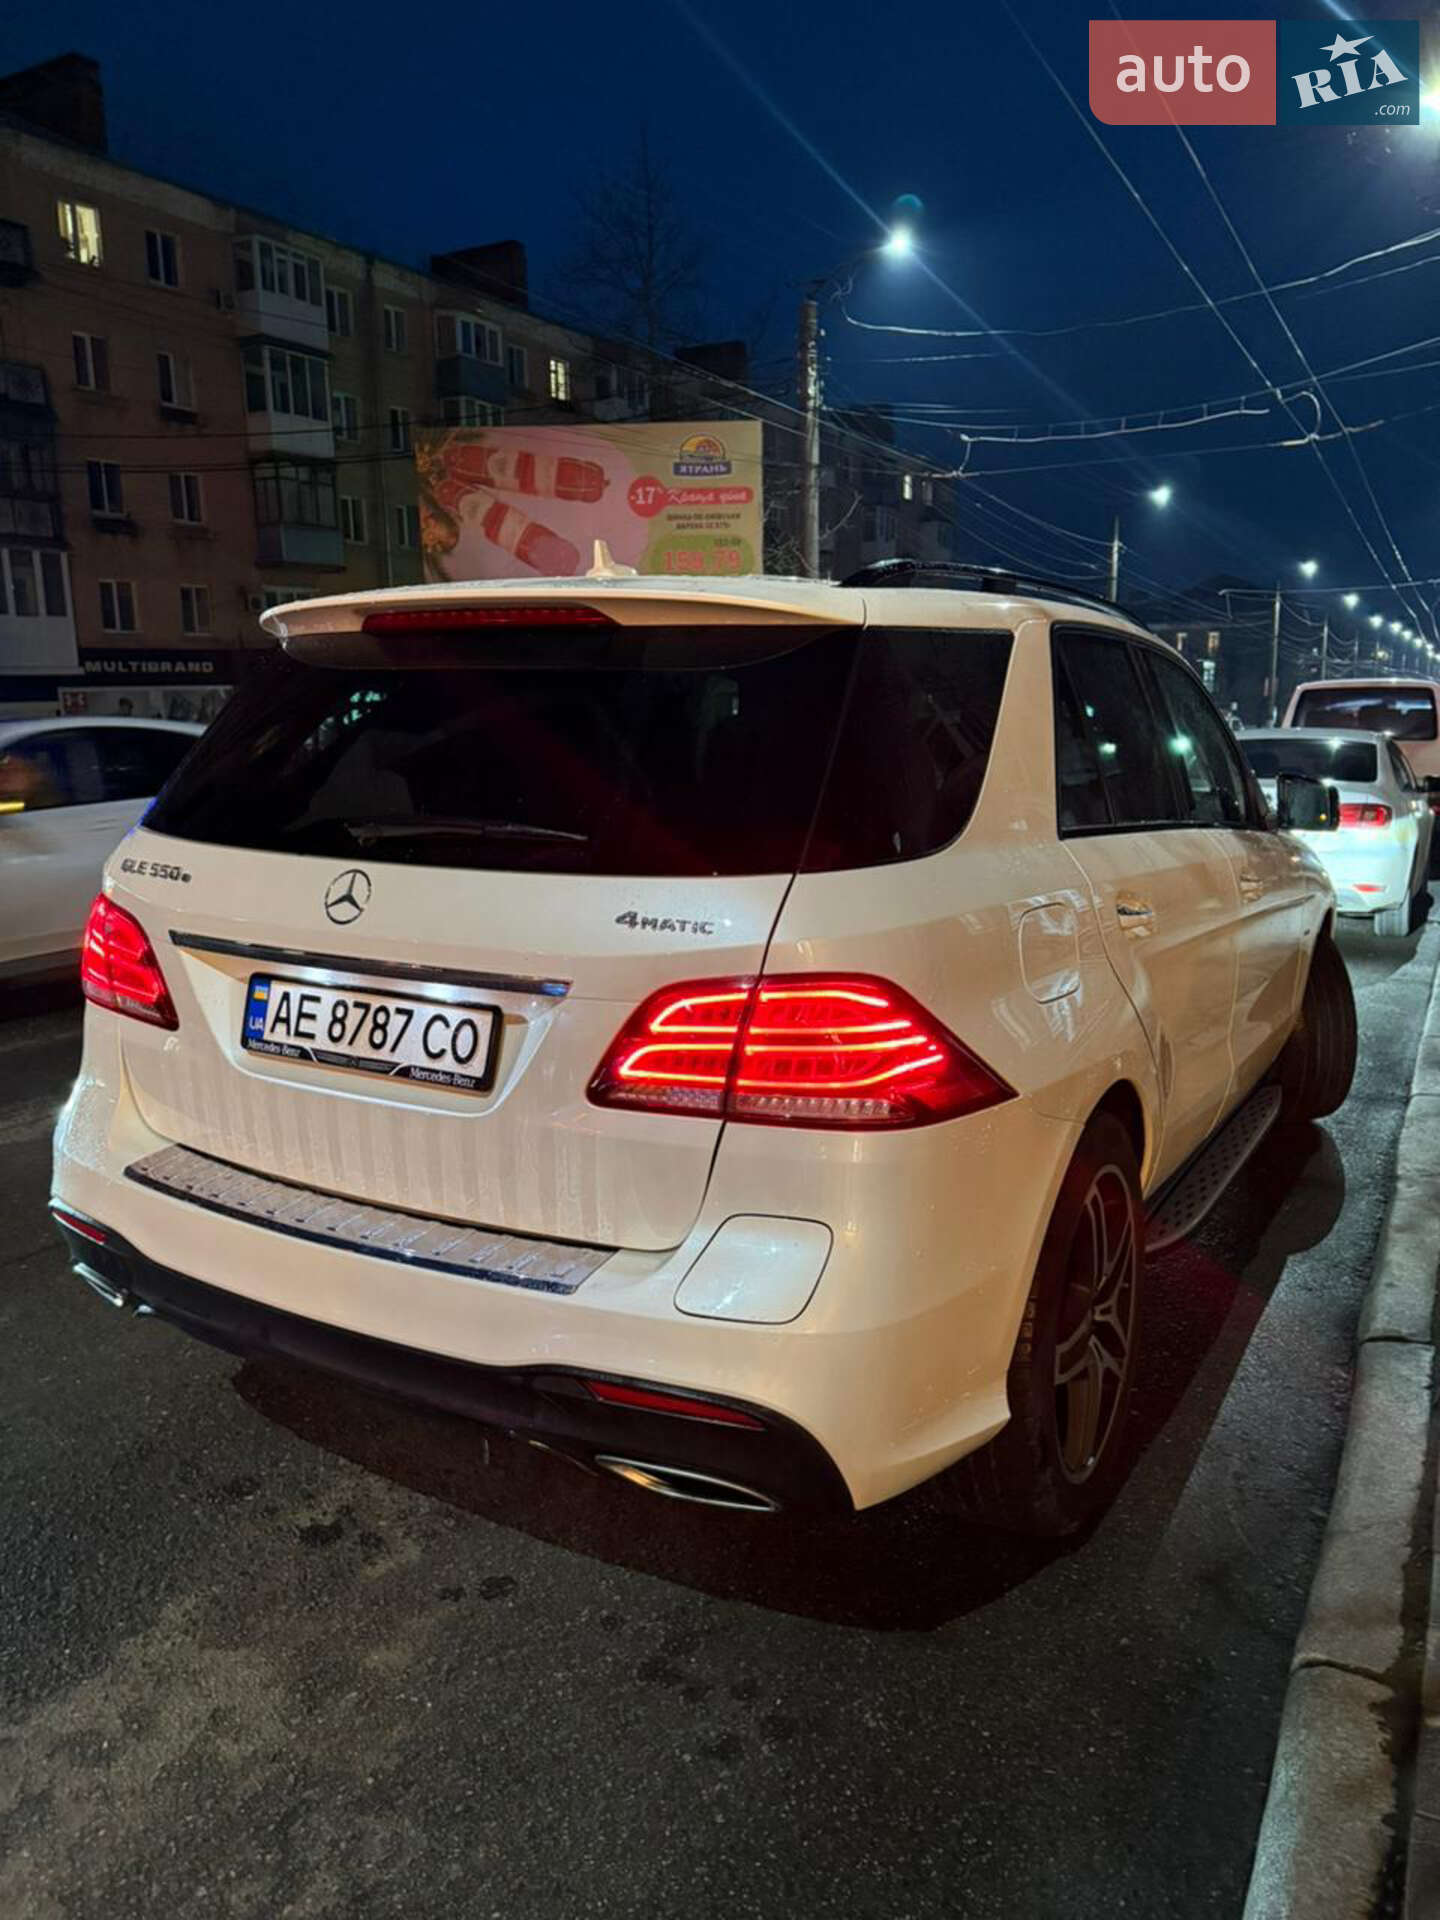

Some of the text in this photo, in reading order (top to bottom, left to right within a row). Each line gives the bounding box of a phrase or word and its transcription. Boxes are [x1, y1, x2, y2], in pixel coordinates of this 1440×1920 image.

[679, 464, 728, 475] ЯТРАНЬ
[84, 660, 214, 673] MULTIBRAND
[615, 911, 715, 935] 4MATIC
[269, 991, 479, 1065] AE 8787 CO
[409, 1066, 477, 1089] Mercedes-Benz
